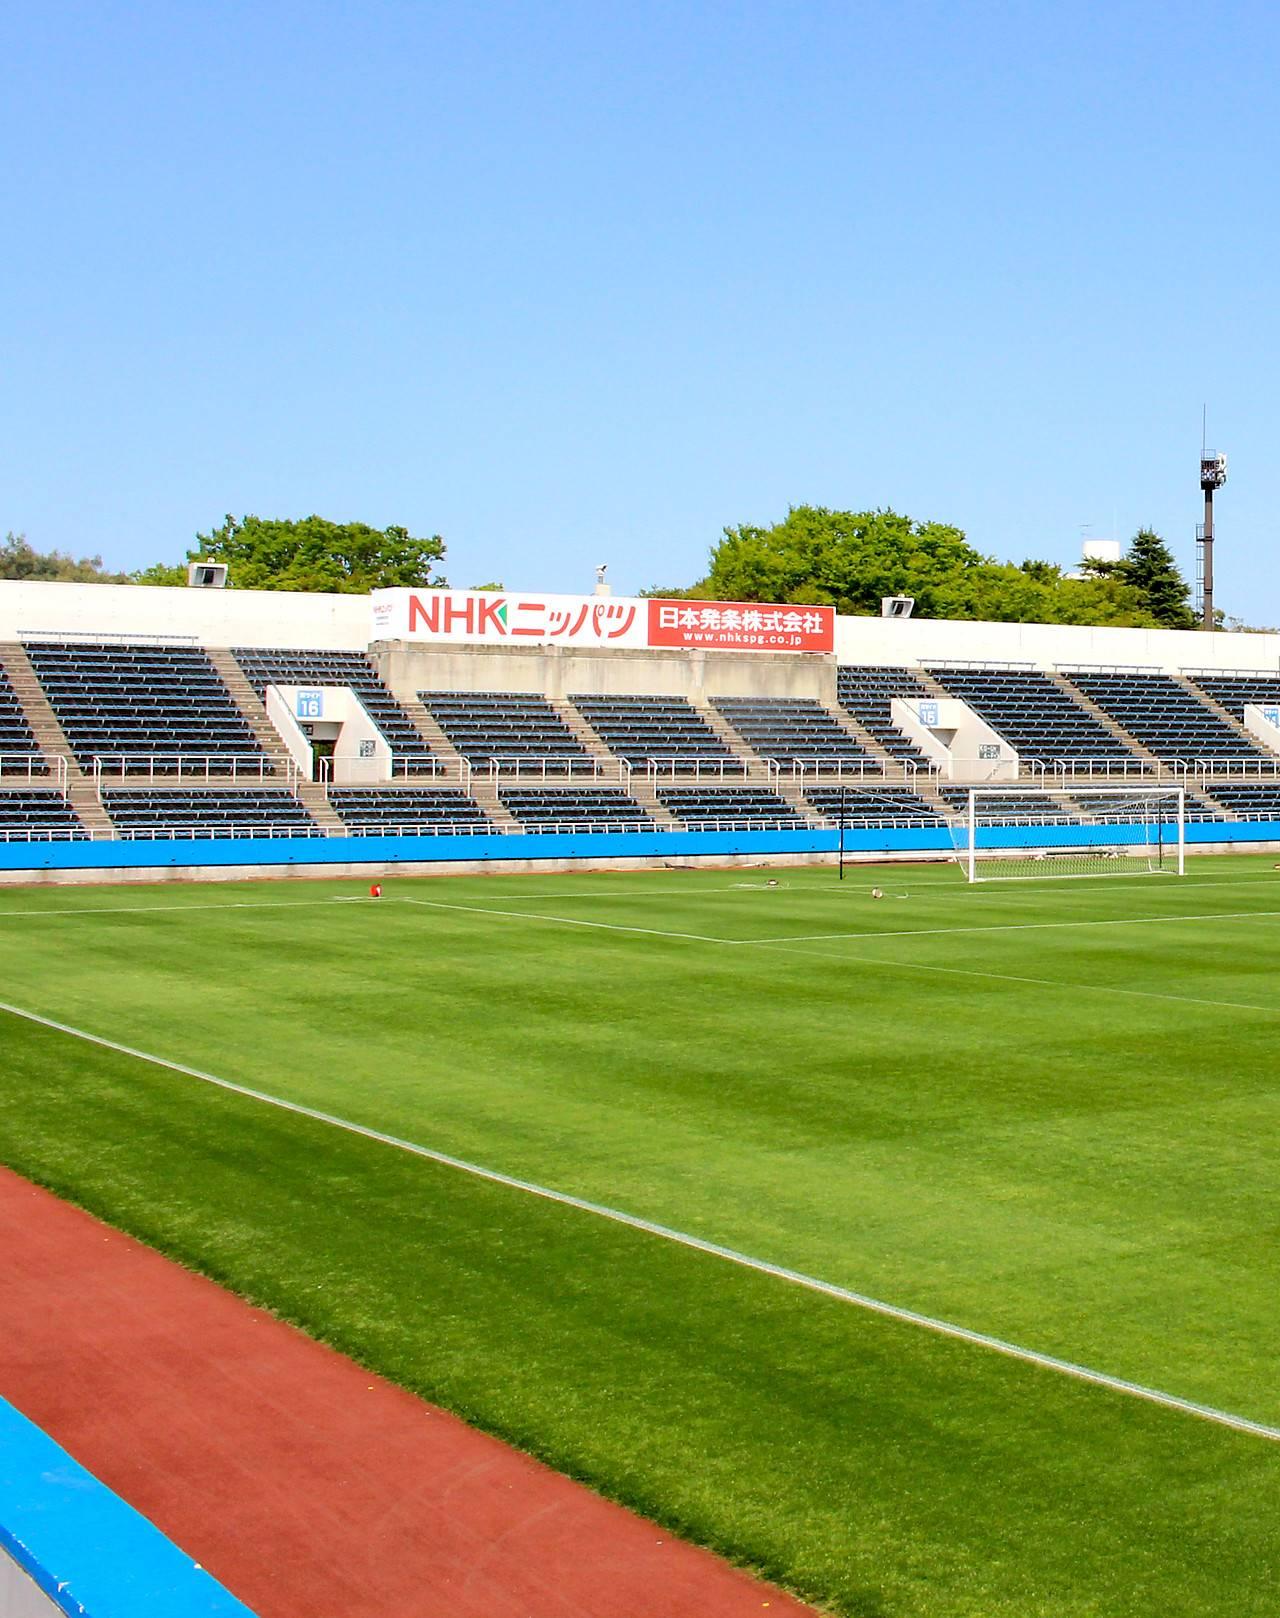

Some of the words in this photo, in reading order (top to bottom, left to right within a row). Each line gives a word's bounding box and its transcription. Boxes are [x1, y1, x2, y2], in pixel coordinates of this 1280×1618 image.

[659, 606, 824, 634] 日本発条株式会社
[683, 632, 802, 646] www.nhkspg.co.jp
[301, 700, 319, 716] 16
